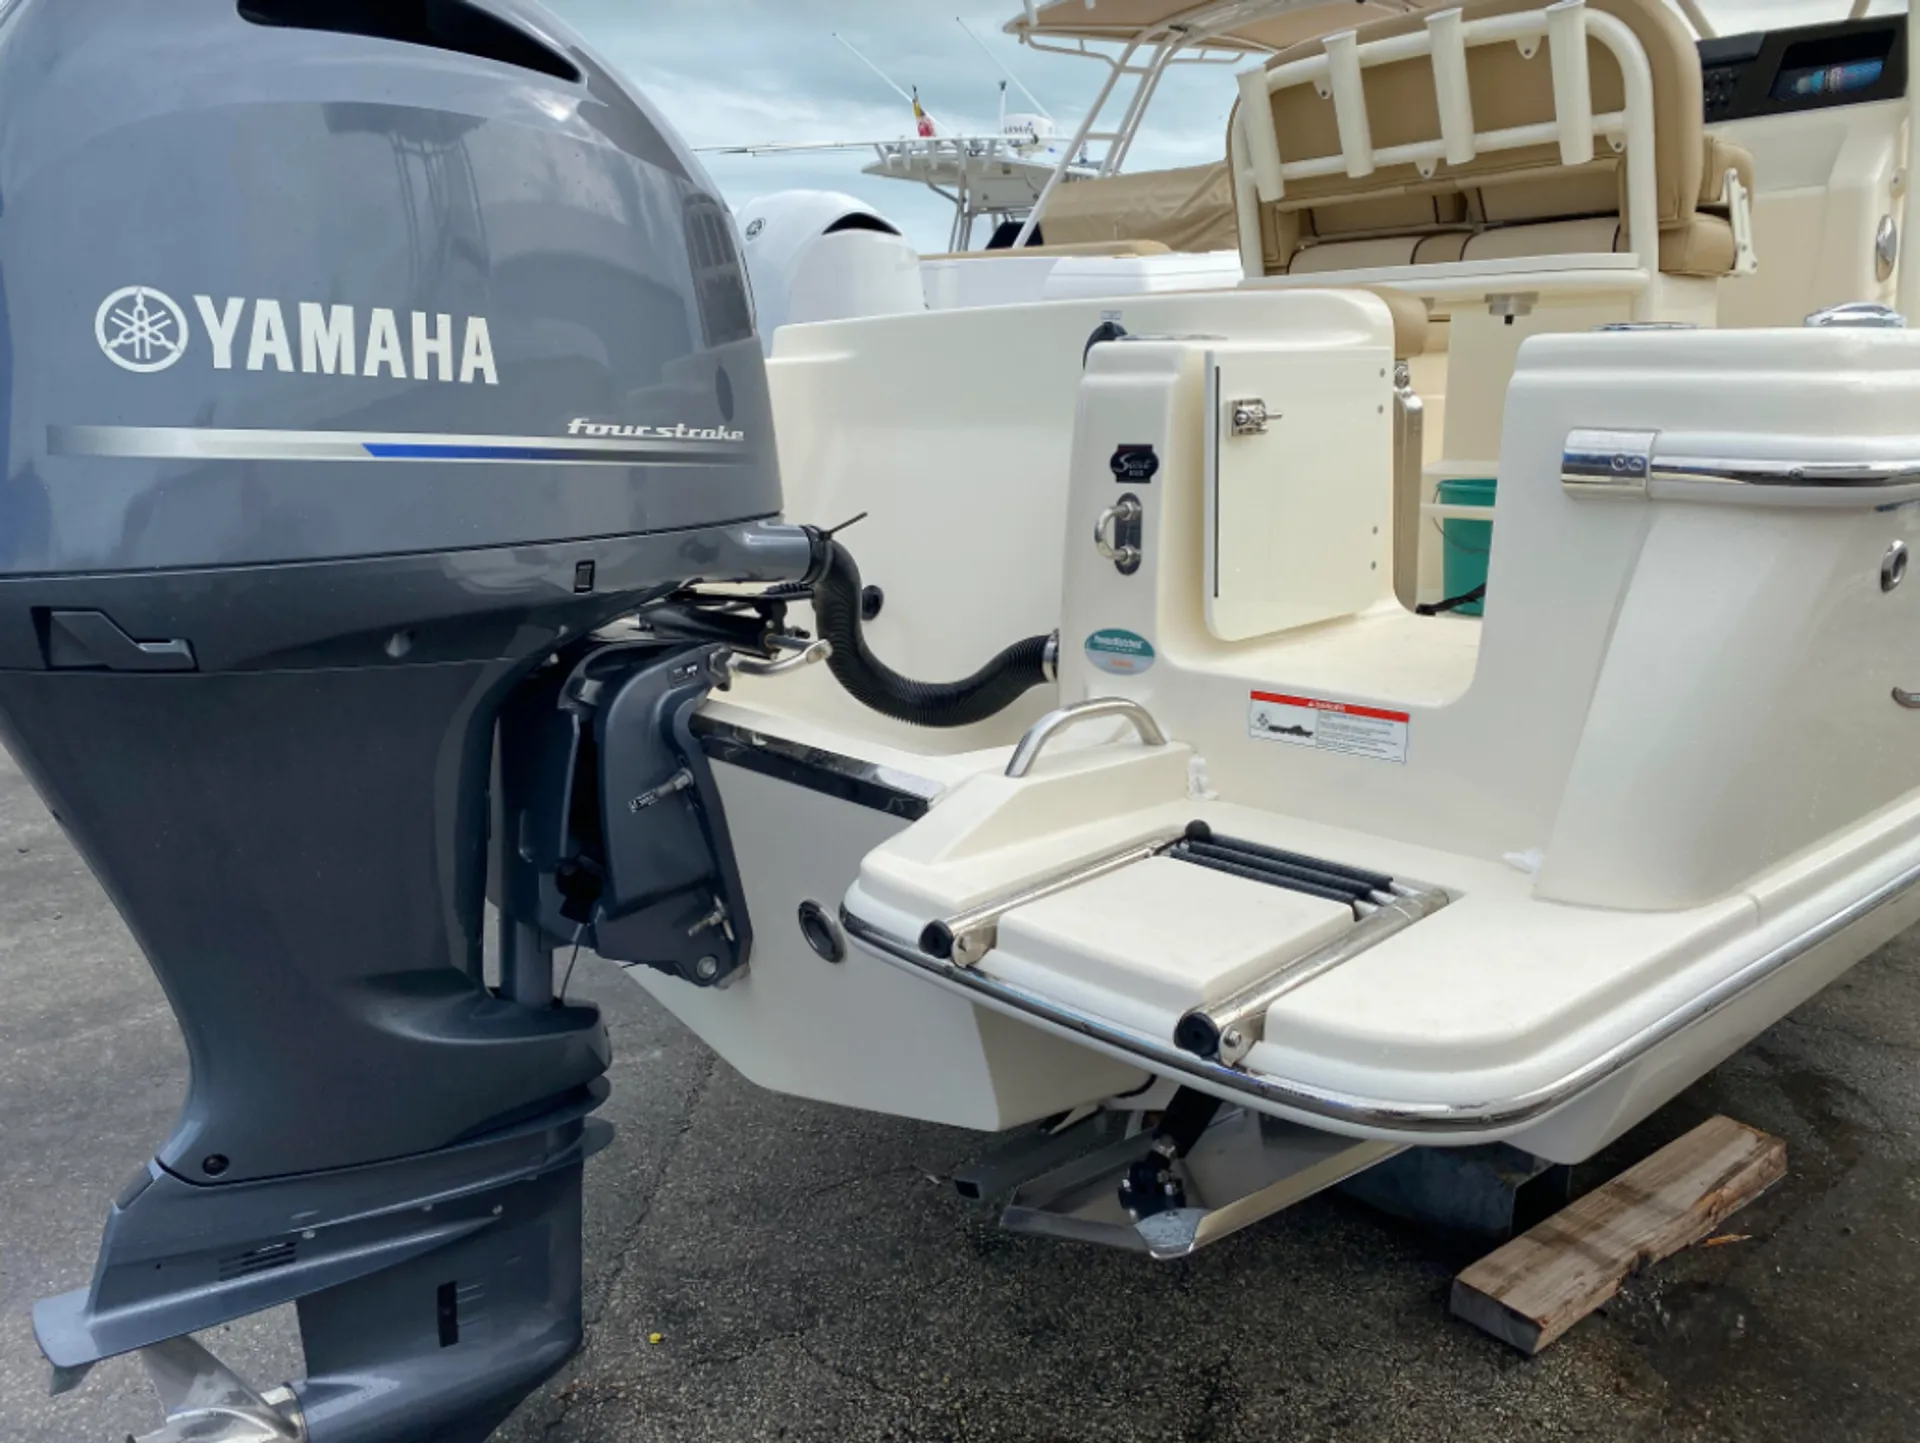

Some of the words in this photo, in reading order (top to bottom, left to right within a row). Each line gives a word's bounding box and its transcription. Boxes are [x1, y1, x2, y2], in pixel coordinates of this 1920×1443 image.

[193, 294, 499, 385] YAMAHA
[568, 417, 650, 437] four
[655, 423, 744, 441] stroke
